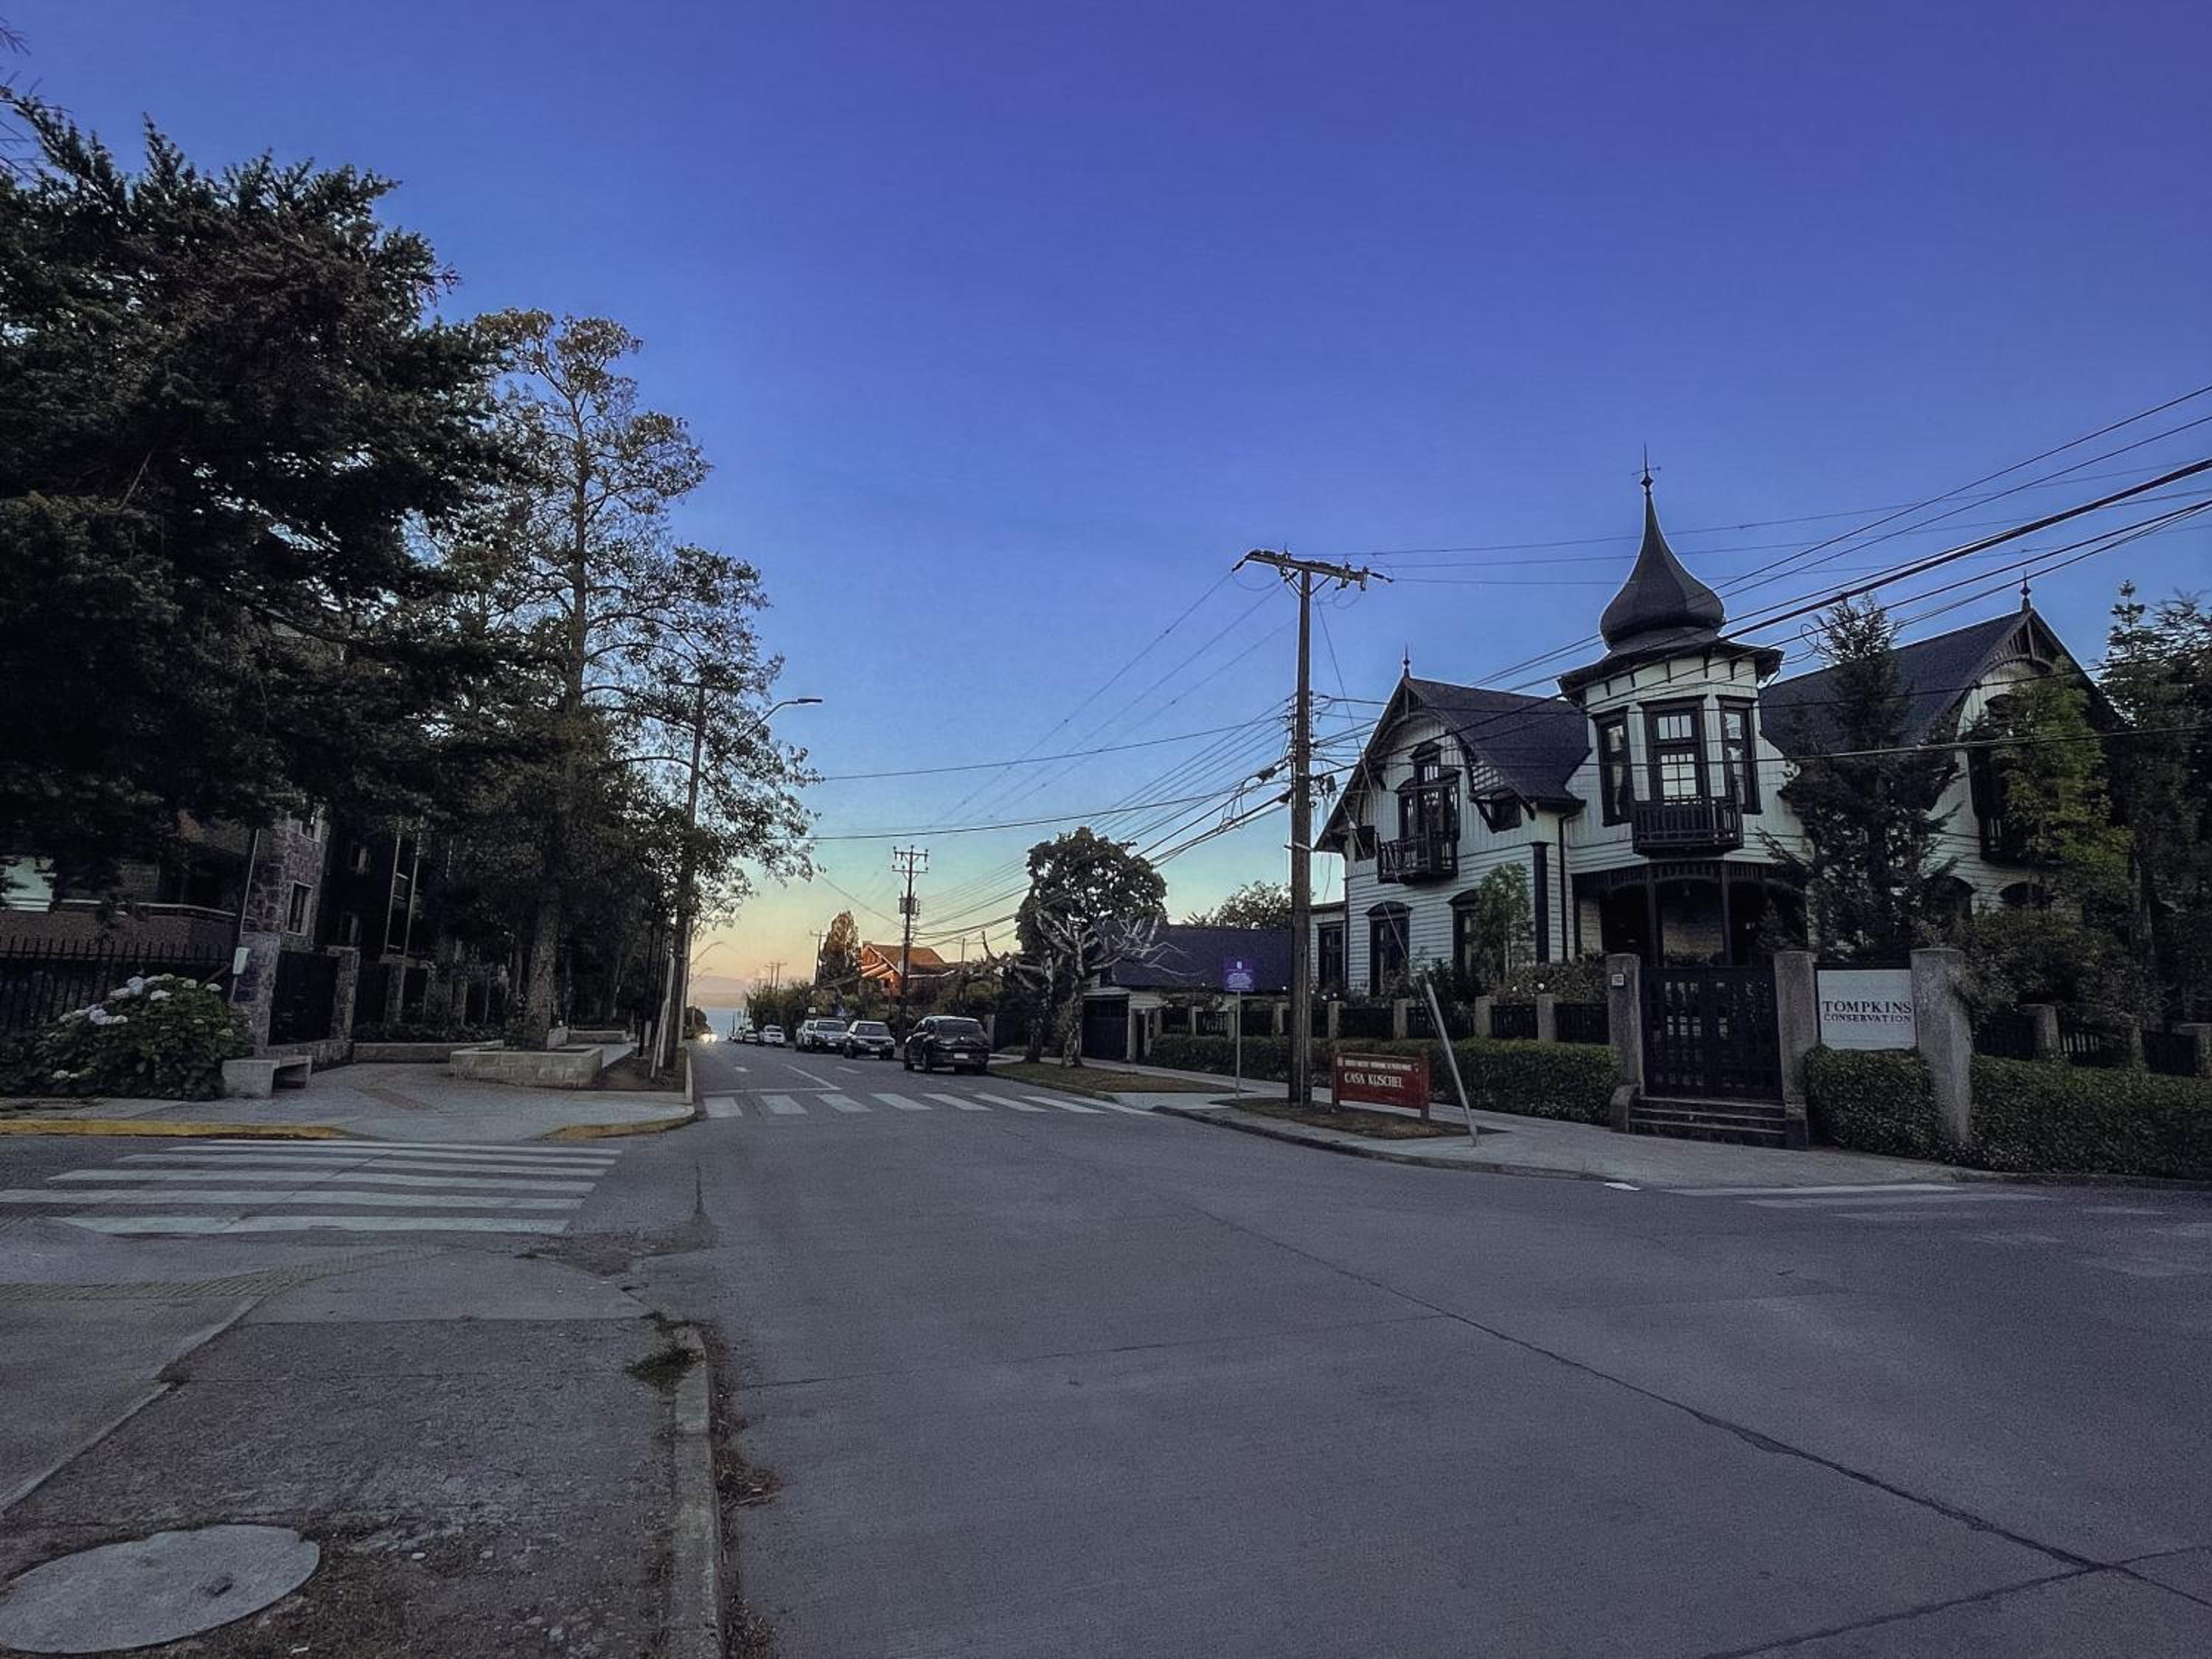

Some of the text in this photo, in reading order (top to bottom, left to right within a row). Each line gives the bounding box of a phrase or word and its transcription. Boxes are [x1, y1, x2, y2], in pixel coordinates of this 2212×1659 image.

[1823, 1001, 1912, 1013] TOMPKINS
[1823, 1014, 1911, 1023] CONSERVATION
[1344, 1073, 1403, 1088] CASA KUSCHEL
